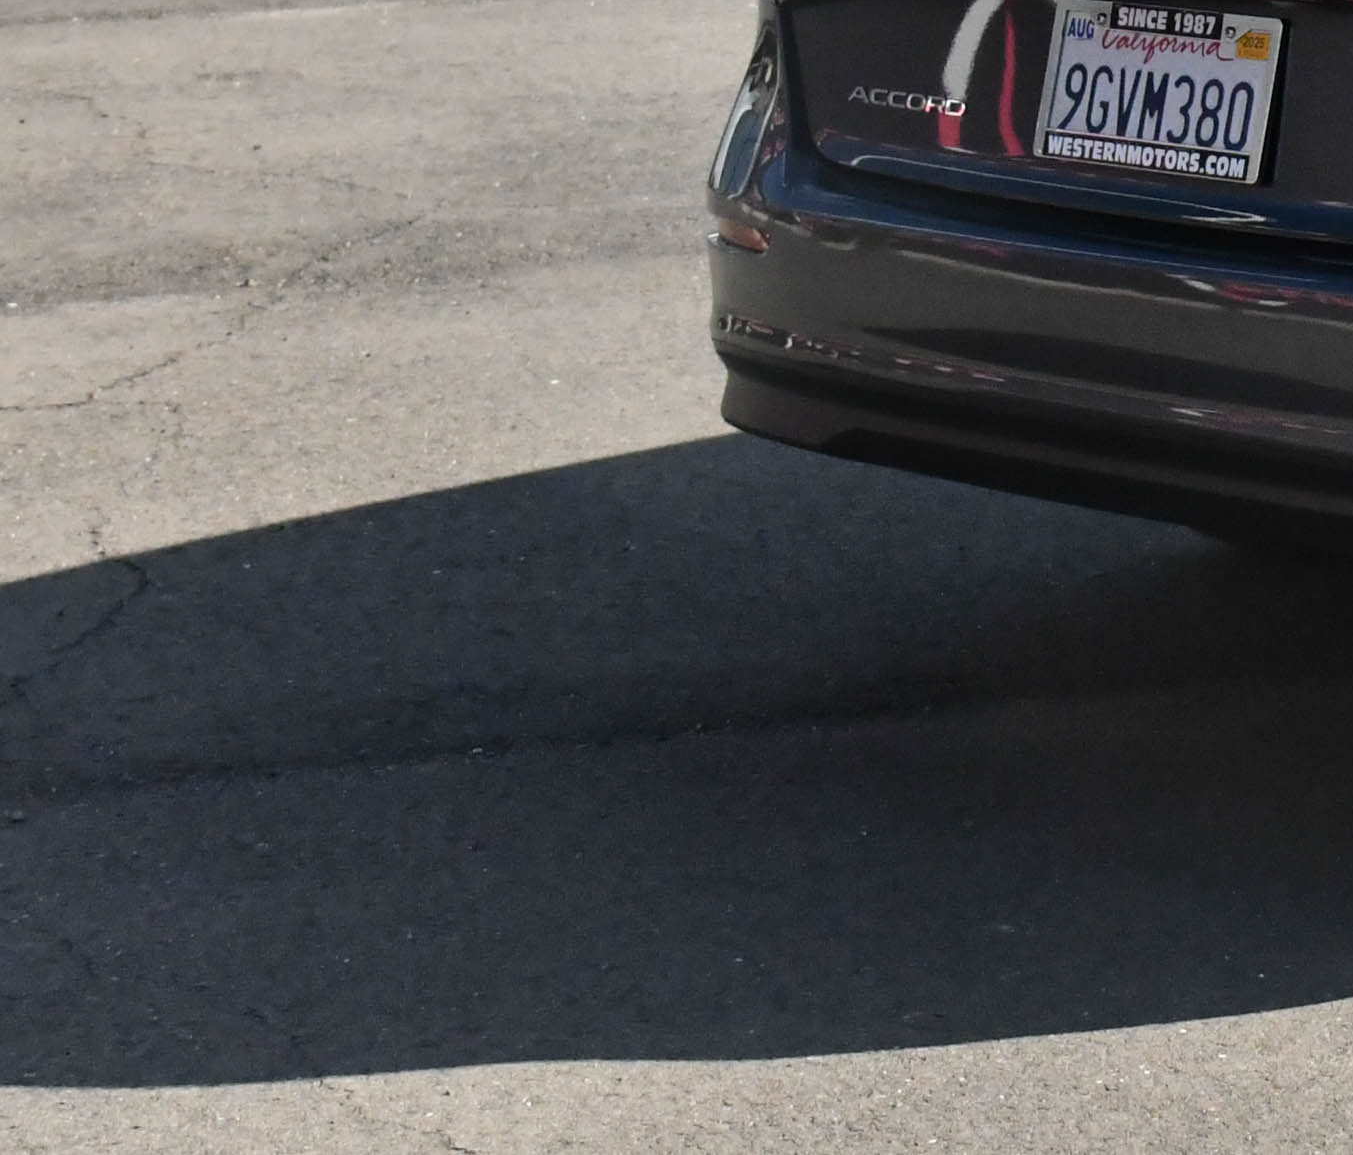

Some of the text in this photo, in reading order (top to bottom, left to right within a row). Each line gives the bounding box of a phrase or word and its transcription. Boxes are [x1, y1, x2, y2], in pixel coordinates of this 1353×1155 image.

[1068, 17, 1095, 39] AUG
[1117, 6, 1216, 35] SINCE 1987
[1102, 29, 1234, 64] California
[848, 86, 966, 116] ACCORD
[1057, 62, 1255, 151] 9GVM380
[1048, 134, 1246, 179] WESTERNMOTORS.COM
